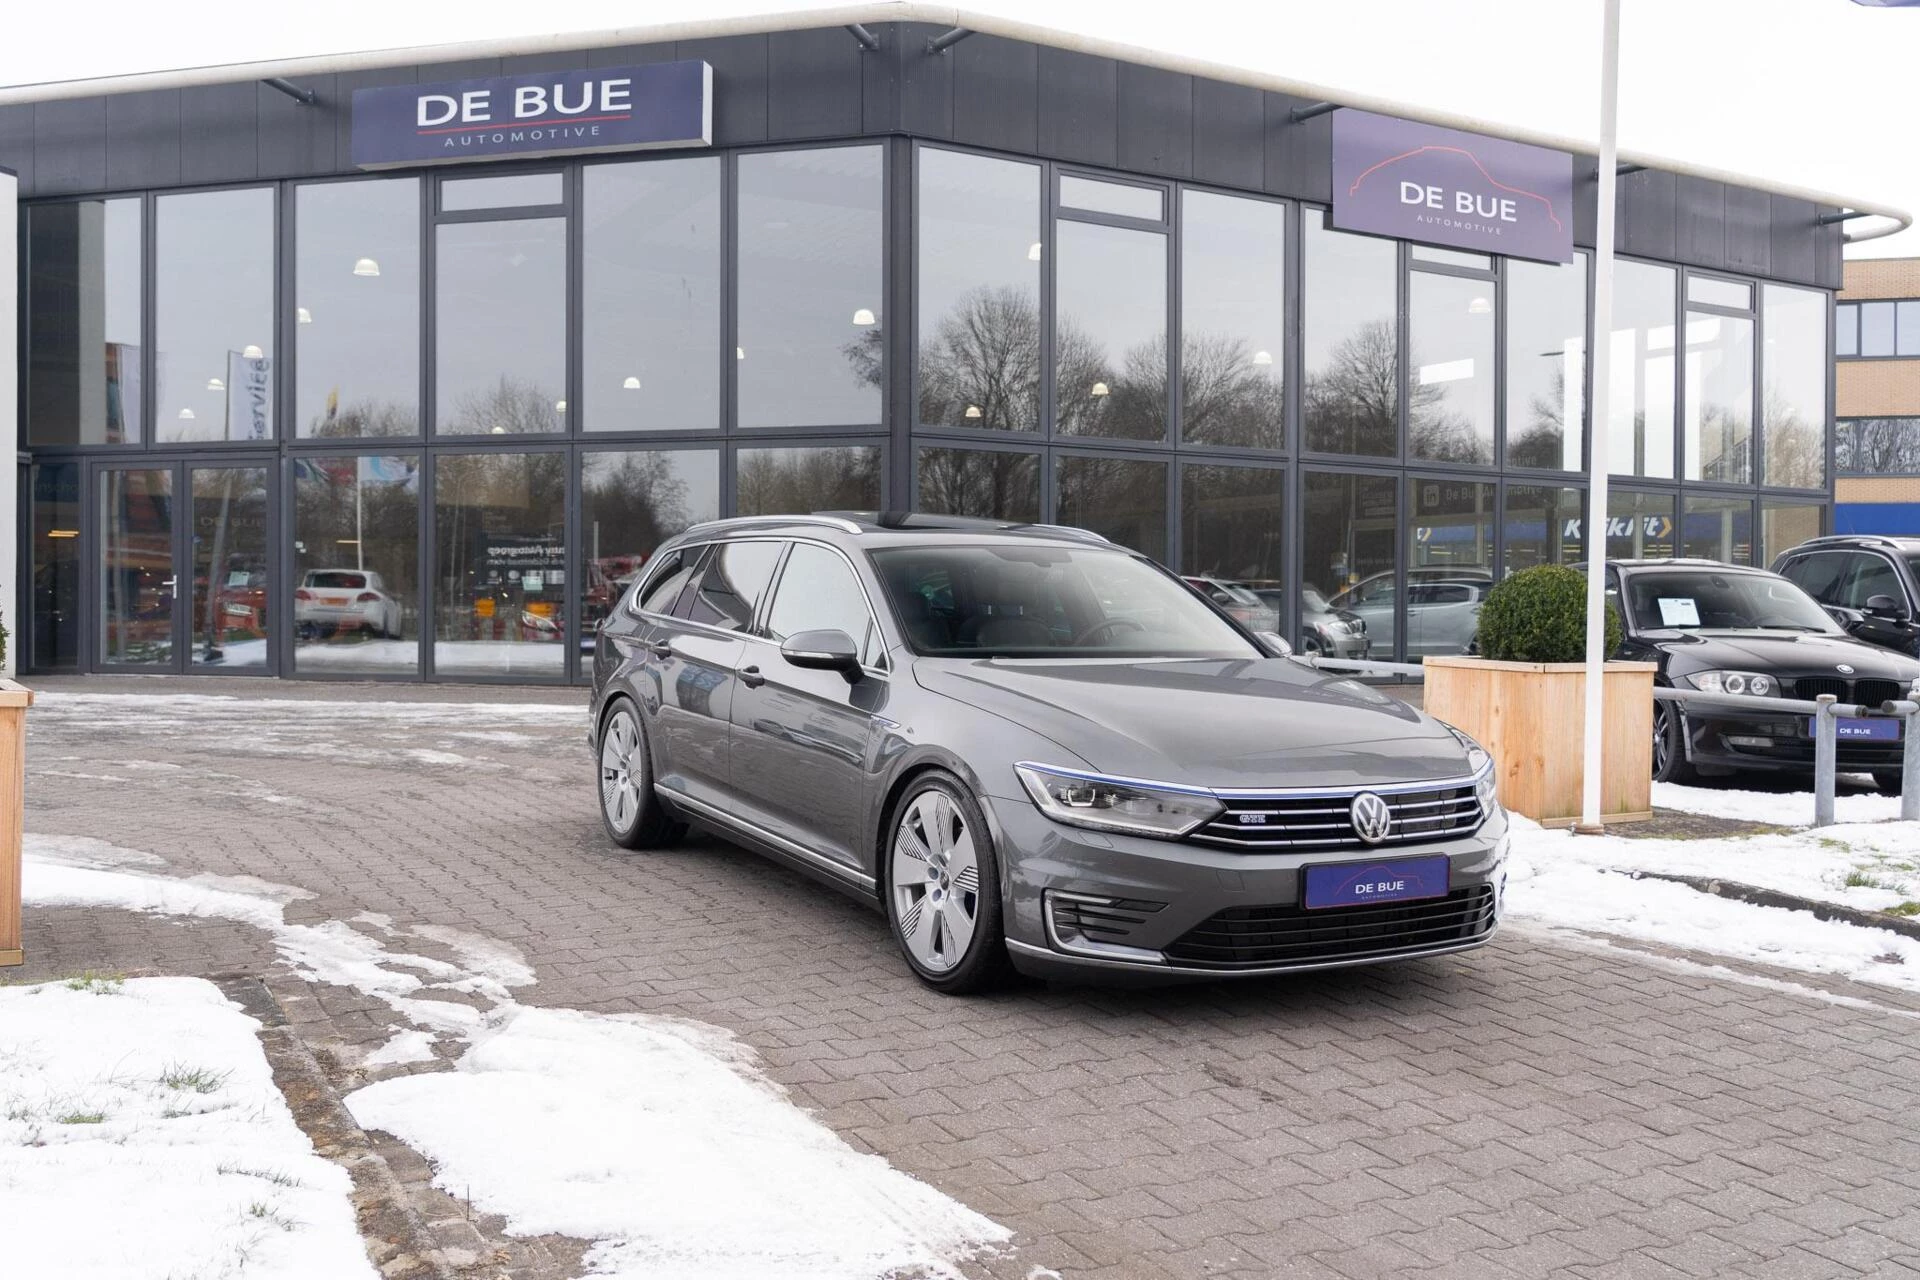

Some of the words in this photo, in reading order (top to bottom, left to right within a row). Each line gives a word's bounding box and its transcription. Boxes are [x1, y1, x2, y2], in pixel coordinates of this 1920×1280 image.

[416, 90, 491, 127] DE
[514, 78, 632, 119] BUE
[443, 125, 600, 148] AUTOMOTIVE
[1400, 181, 1444, 210] DE
[1455, 191, 1518, 223] BUE
[1416, 215, 1502, 235] AUTOMOTIVE
[1460, 487, 1480, 500] Bu
[1239, 814, 1267, 824] GTE
[1355, 883, 1374, 894] DE
[1377, 880, 1405, 892] BUE
